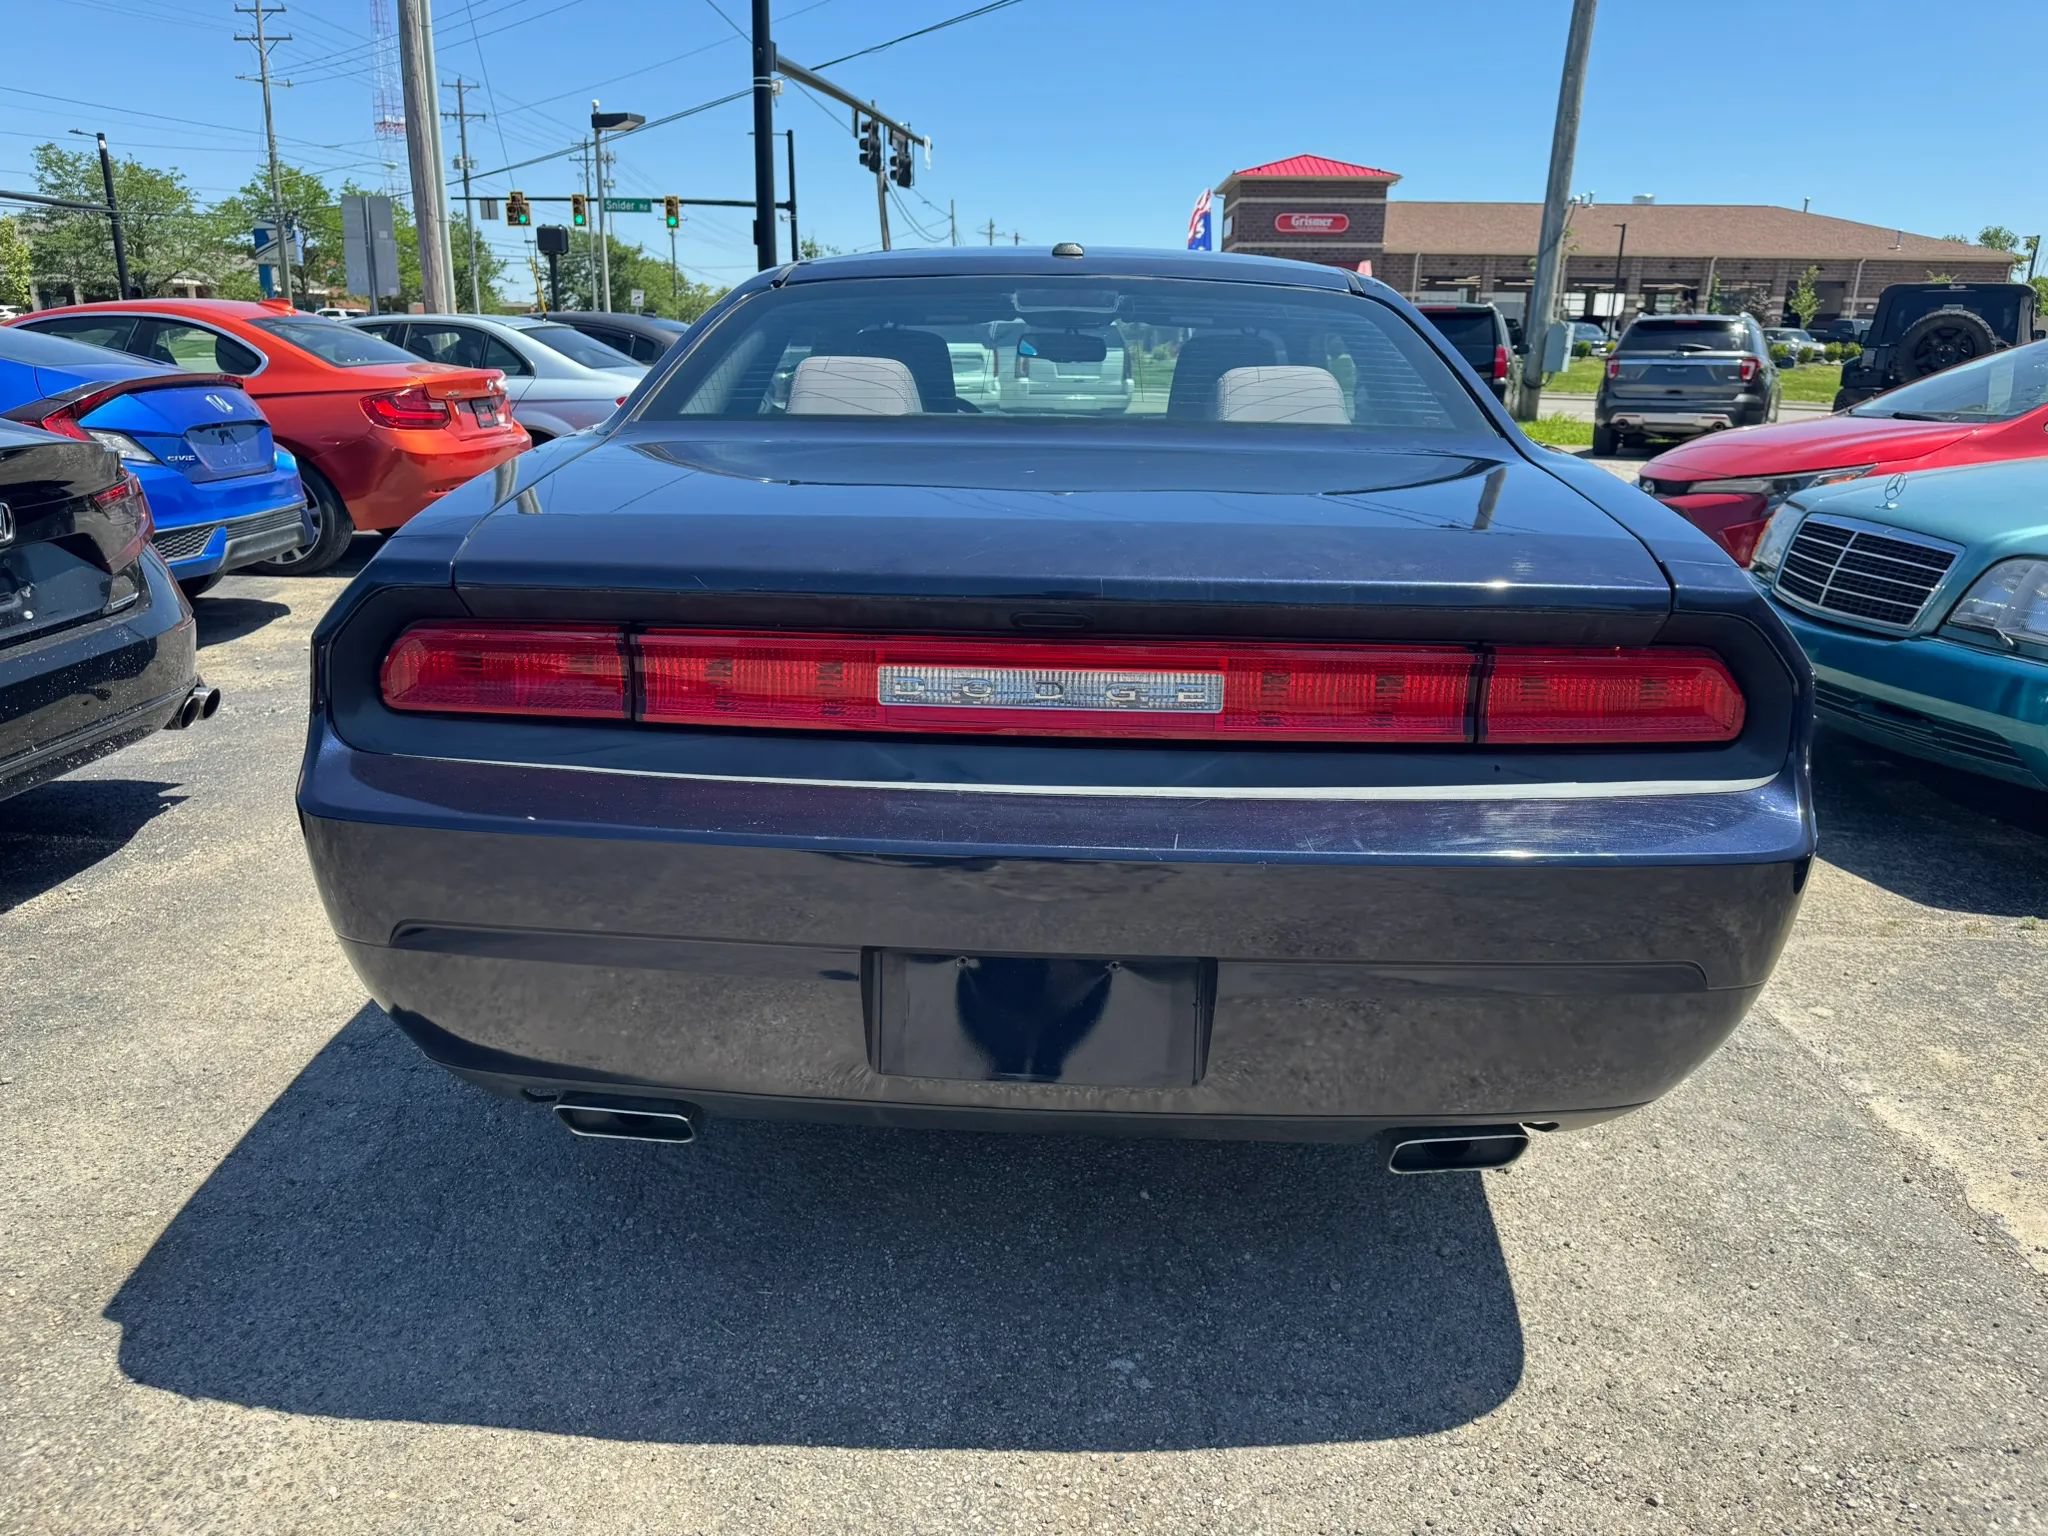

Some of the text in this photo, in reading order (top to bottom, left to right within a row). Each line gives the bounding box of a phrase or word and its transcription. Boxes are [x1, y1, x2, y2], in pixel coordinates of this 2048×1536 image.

[605, 200, 635, 210] Snider
[1291, 215, 1334, 227] Grismer
[895, 676, 1205, 702] DODGE
